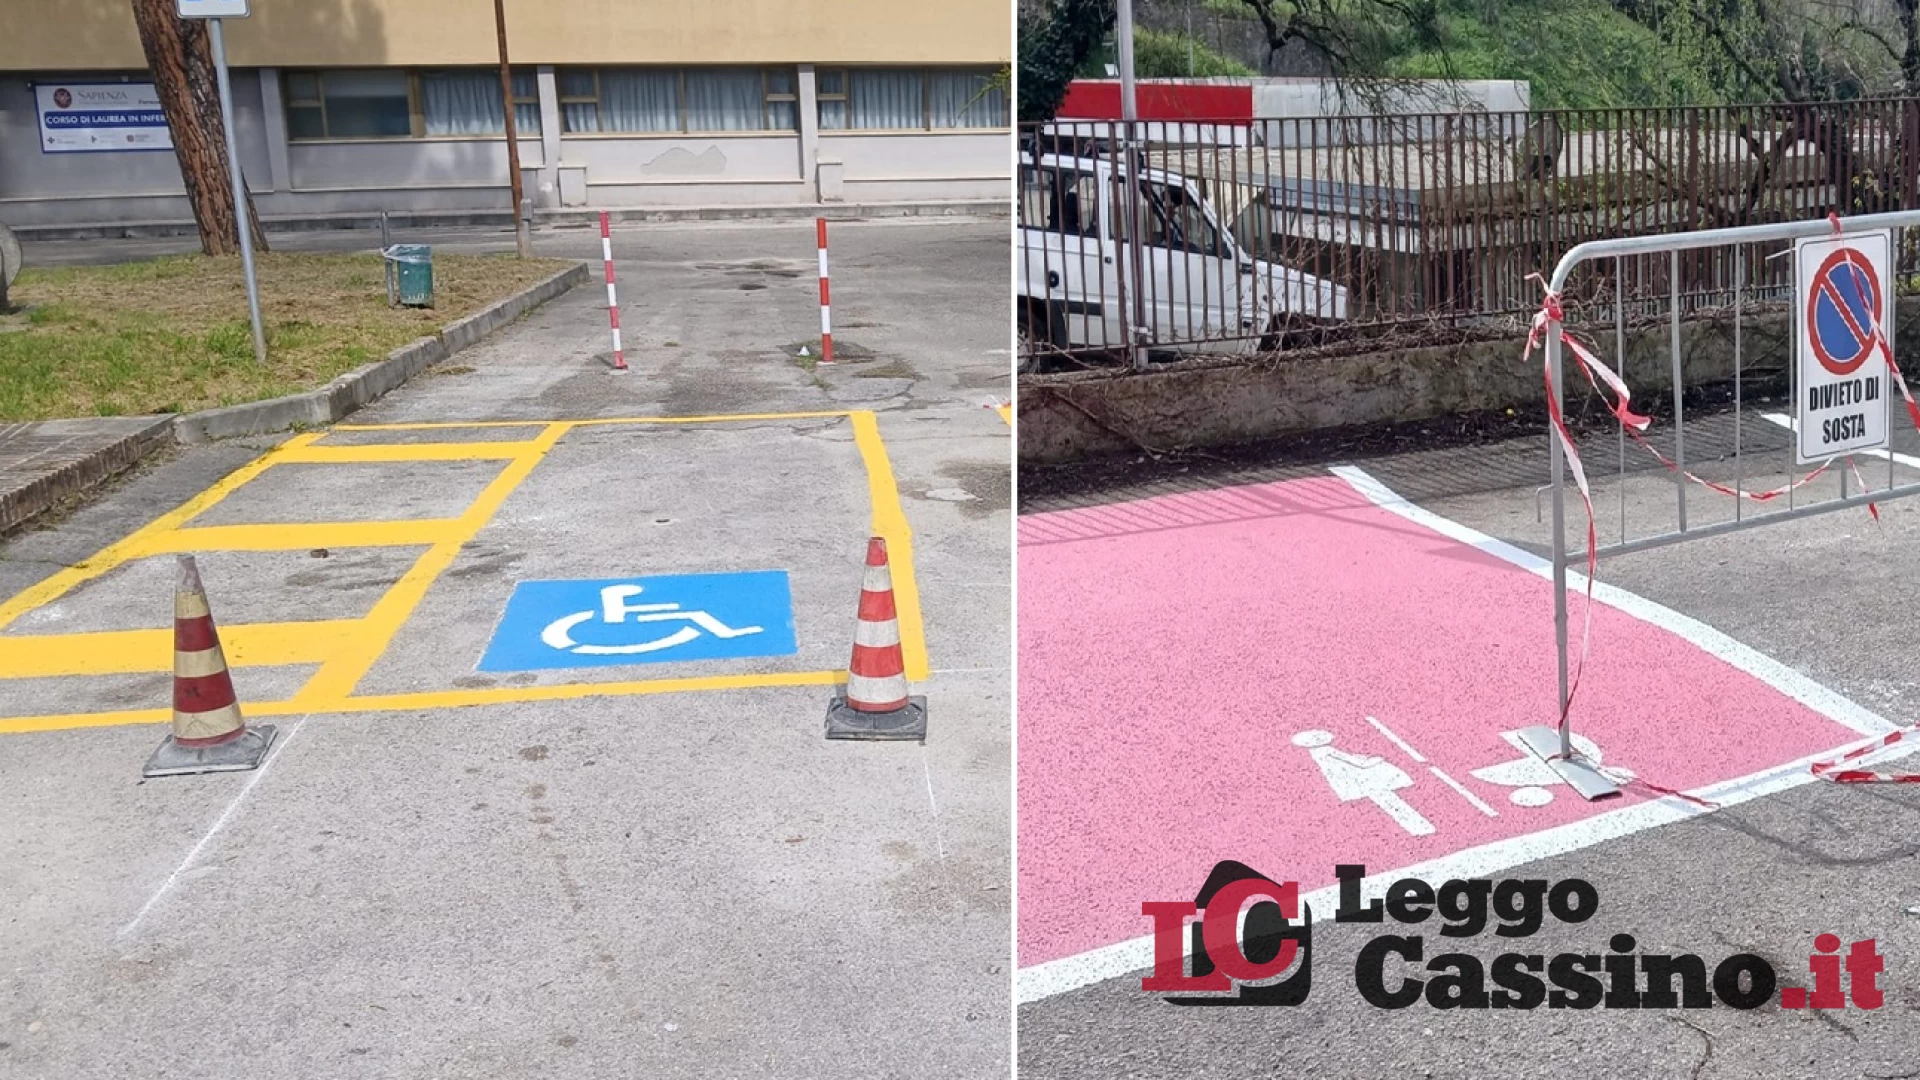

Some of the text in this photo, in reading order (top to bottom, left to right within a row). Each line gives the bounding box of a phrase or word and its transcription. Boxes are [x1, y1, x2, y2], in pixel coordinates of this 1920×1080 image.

[77, 90, 128, 100] SAPIENZA
[46, 116, 78, 124] CORSO
[80, 115, 90, 123] DI
[92, 115, 126, 123] LAUREA
[1809, 375, 1879, 412] DIVIETO DI
[1822, 413, 1866, 444] SOSTA
